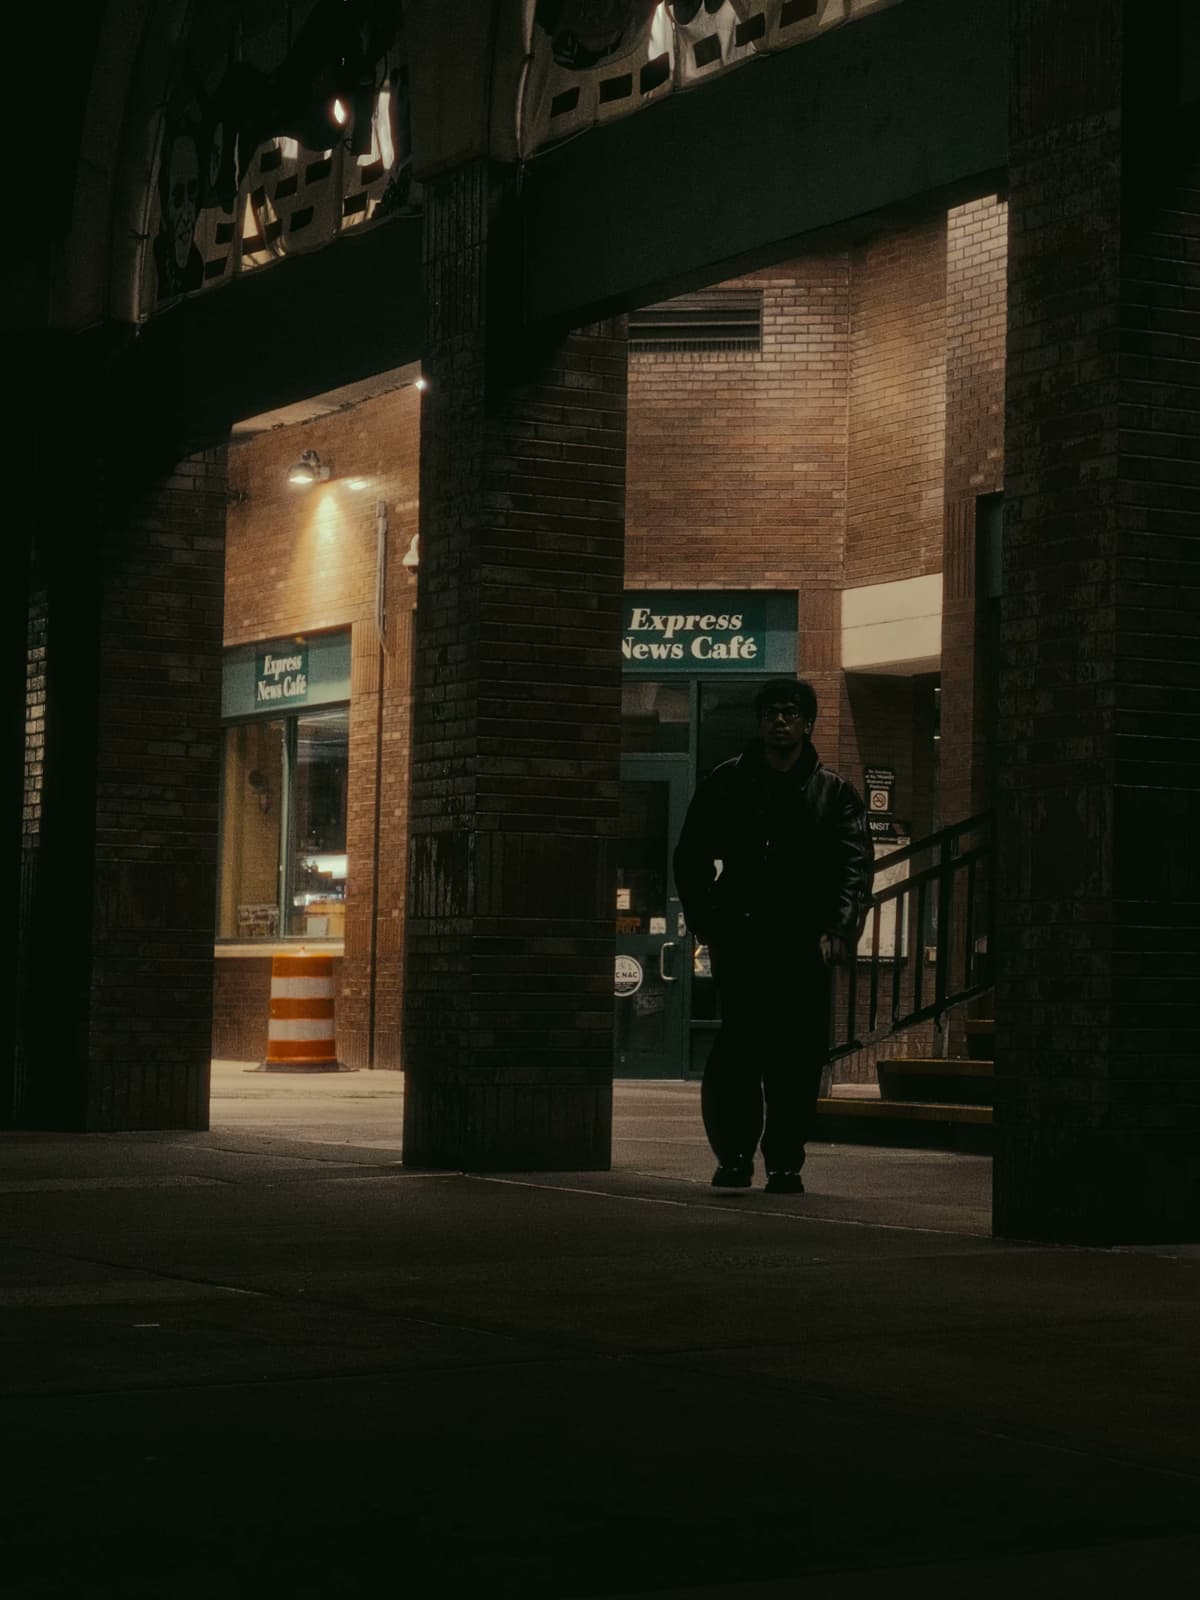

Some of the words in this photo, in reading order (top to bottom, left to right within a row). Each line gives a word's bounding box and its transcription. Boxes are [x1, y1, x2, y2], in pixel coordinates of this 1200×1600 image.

[627, 608, 743, 638] Express
[622, 636, 684, 660] News
[691, 635, 758, 660] Café
[263, 655, 303, 680] Express
[257, 680, 282, 701] News
[283, 674, 307, 697] Café
